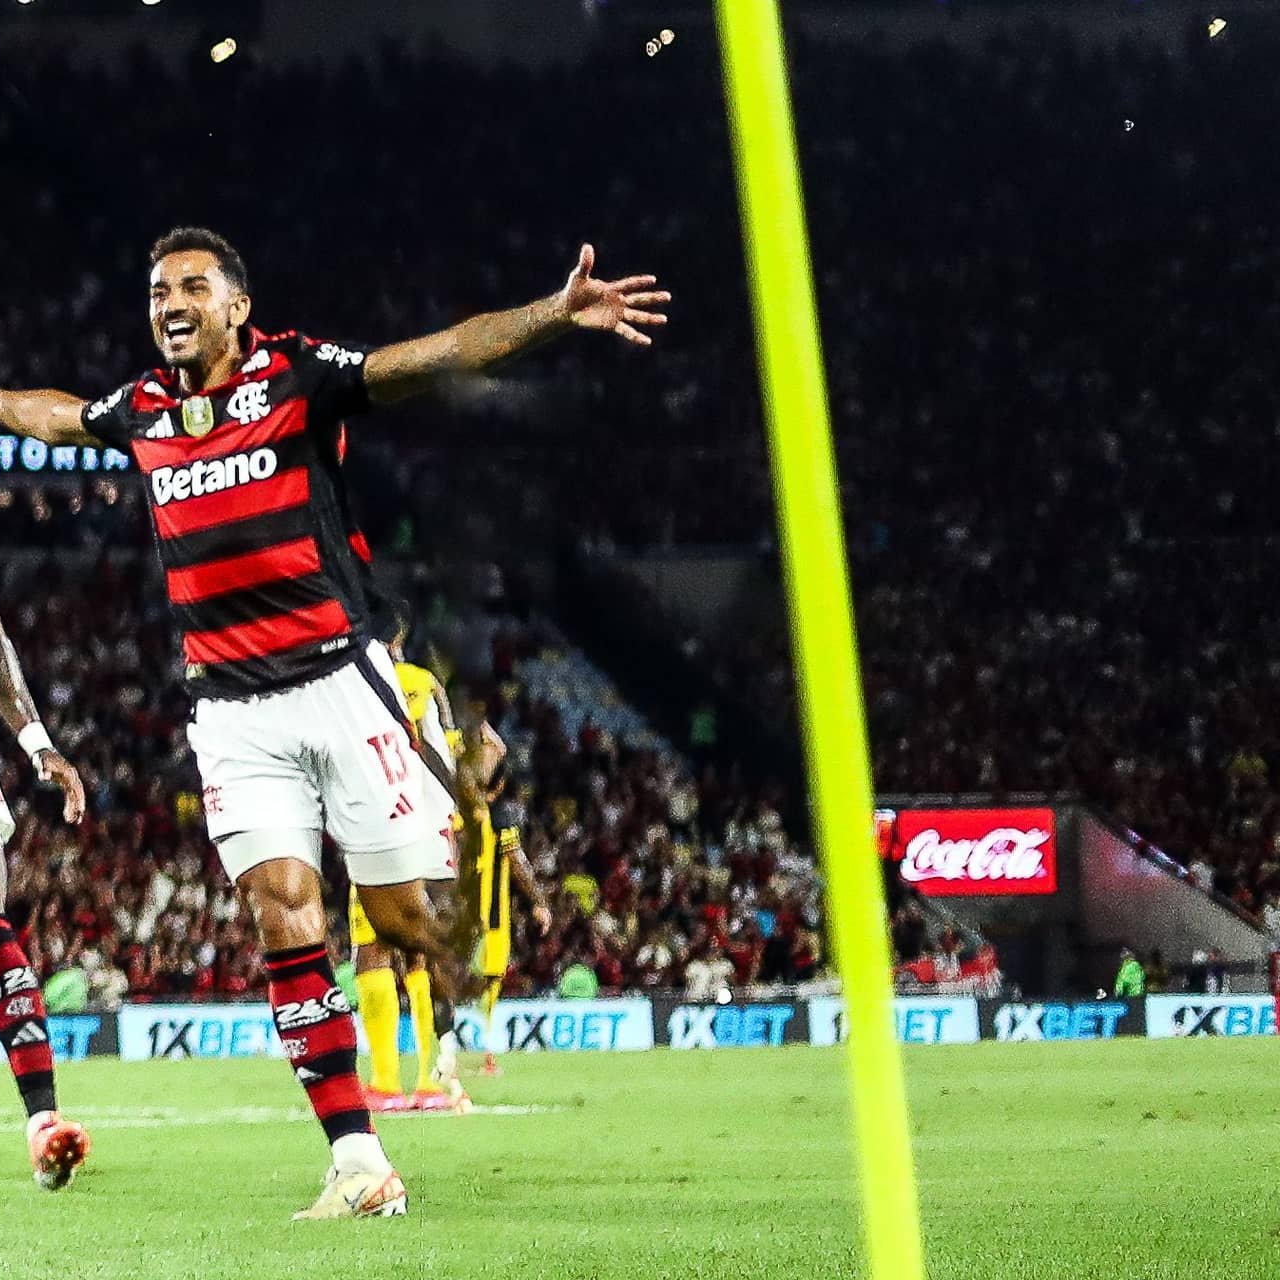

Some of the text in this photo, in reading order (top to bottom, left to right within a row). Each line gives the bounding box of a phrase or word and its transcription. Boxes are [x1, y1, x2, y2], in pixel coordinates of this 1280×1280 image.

[151, 447, 278, 507] Betano
[506, 1013, 629, 1051] 1XBET
[668, 1003, 795, 1049] 1XBET
[993, 1002, 1129, 1041] 1XBET
